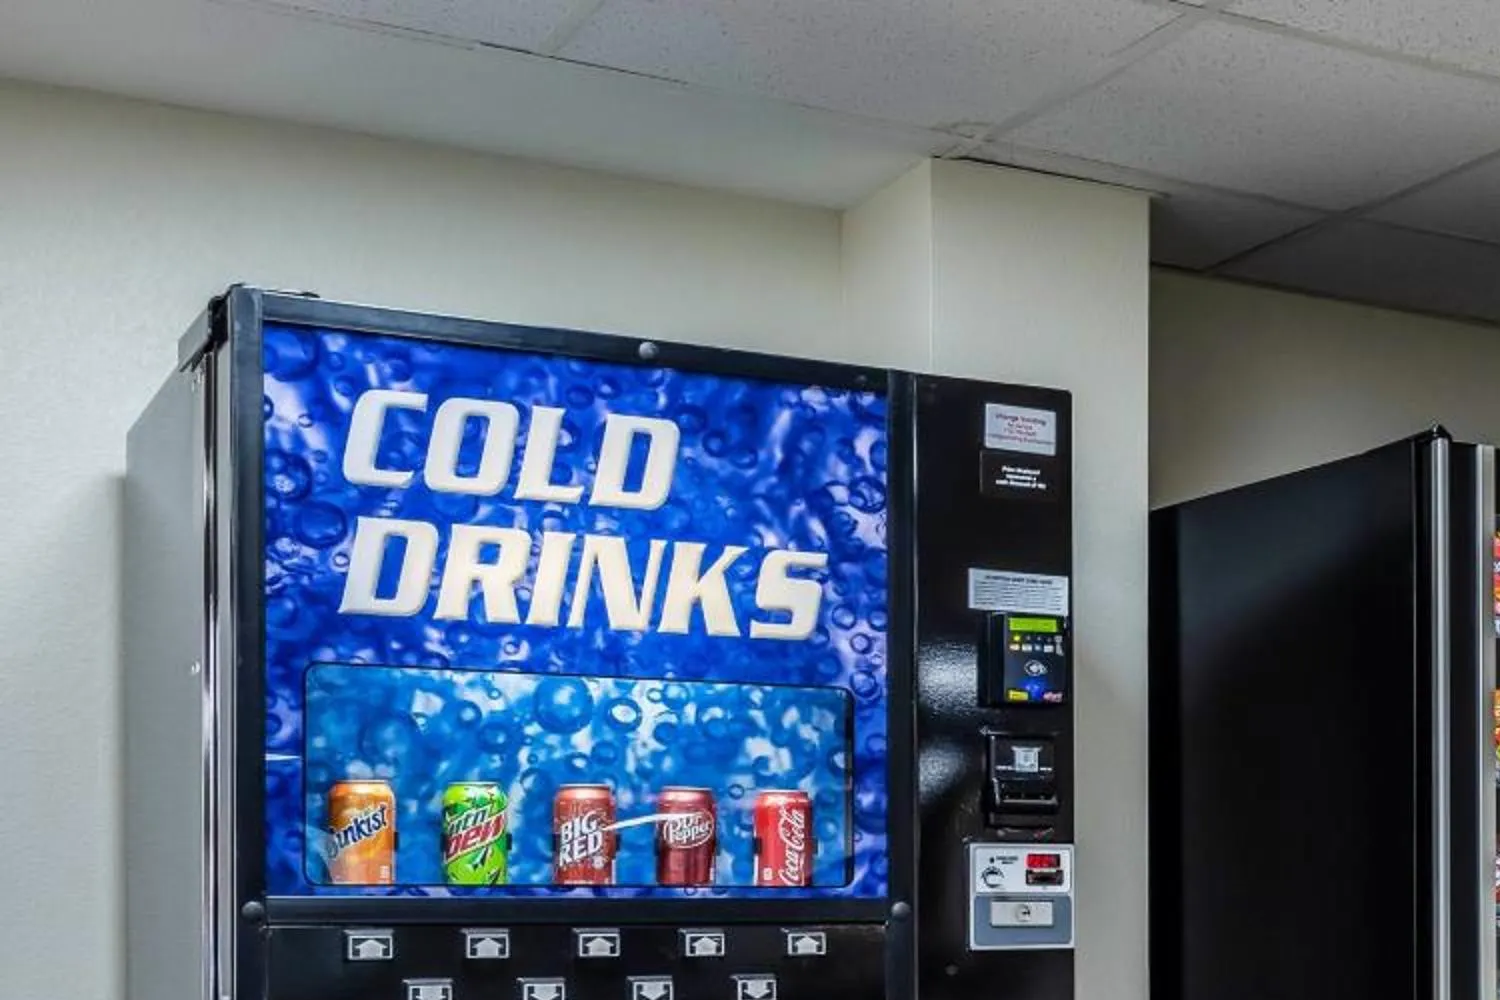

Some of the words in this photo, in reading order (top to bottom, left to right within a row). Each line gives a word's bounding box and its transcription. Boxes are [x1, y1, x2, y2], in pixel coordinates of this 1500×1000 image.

[343, 388, 681, 510] COLD
[338, 516, 828, 640] DRINKS
[561, 810, 598, 844] BIG
[669, 818, 712, 845] Pepper
[559, 830, 603, 866] RED
